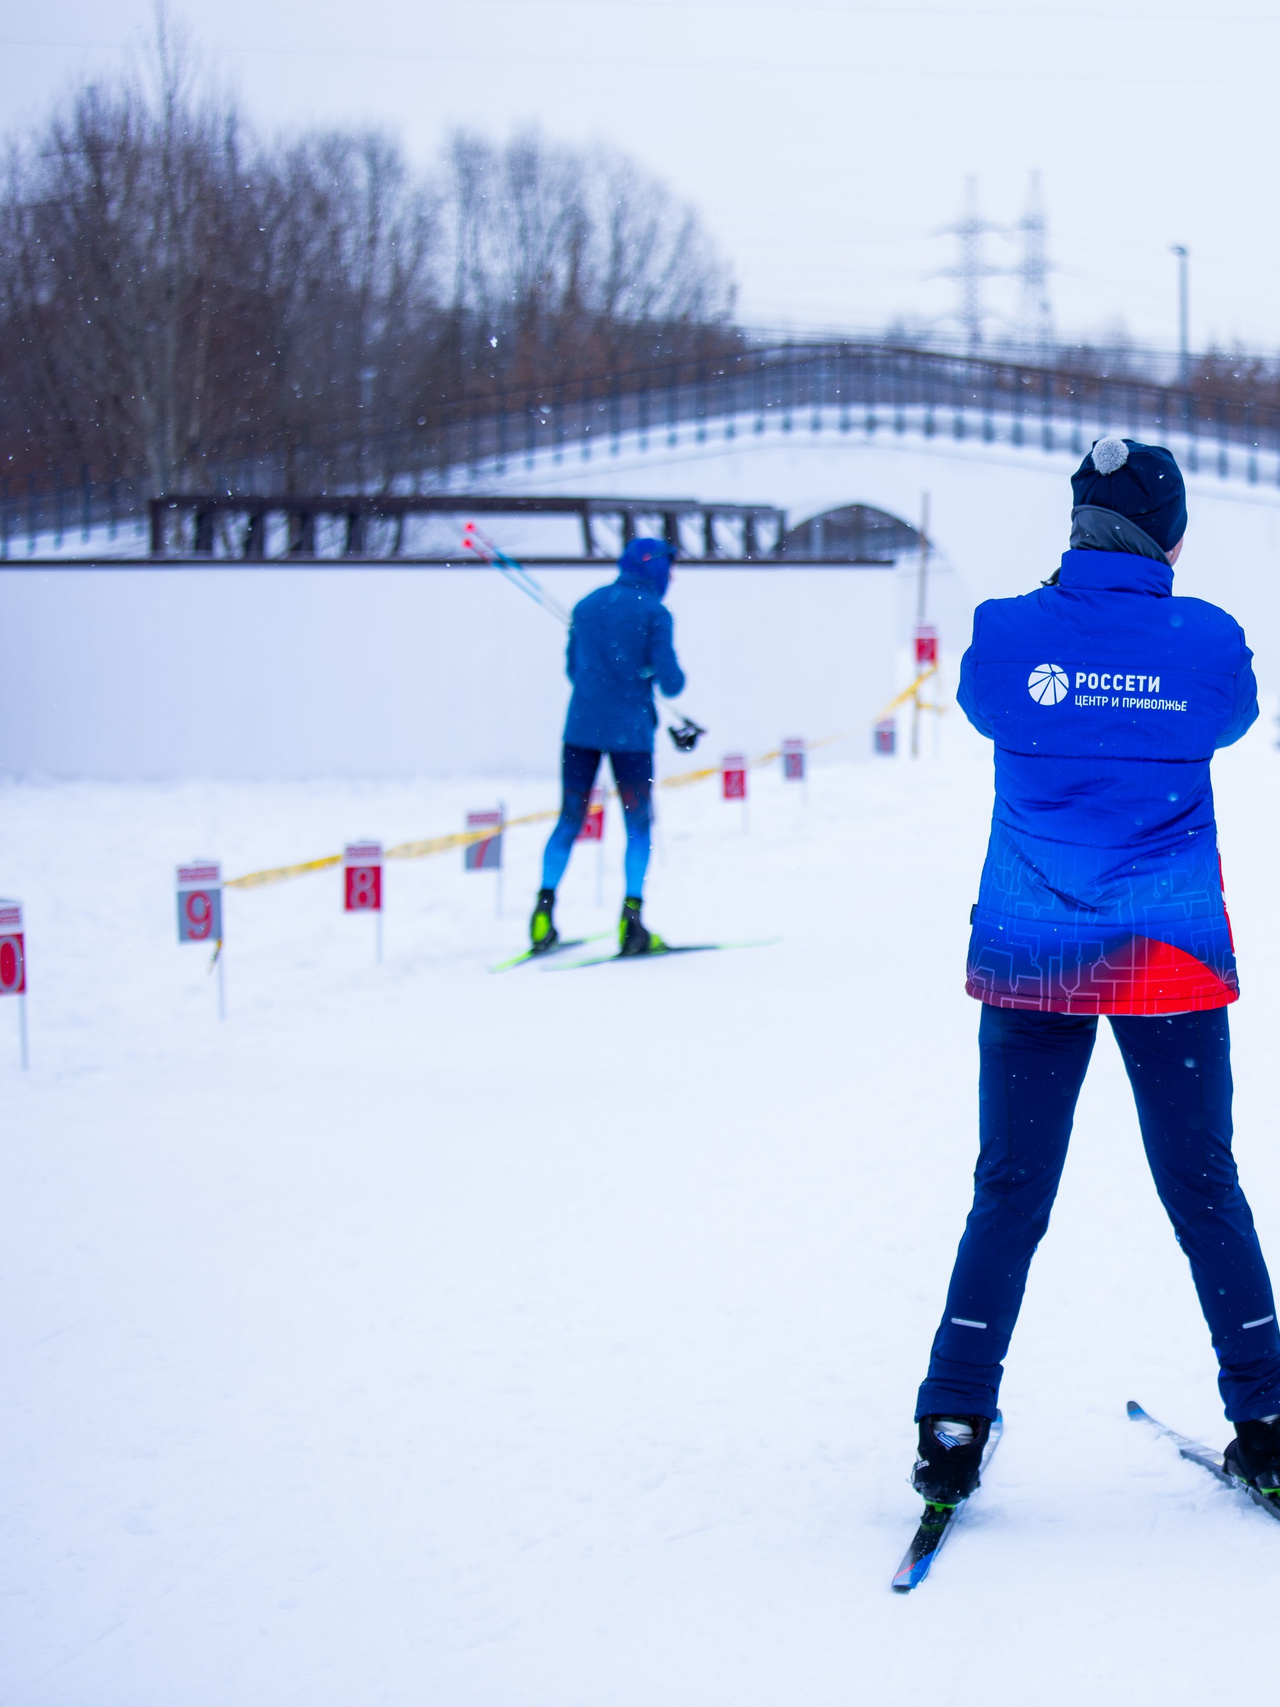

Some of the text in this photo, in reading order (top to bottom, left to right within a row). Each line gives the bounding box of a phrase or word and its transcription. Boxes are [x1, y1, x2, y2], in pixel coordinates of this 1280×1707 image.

[1075, 672, 1160, 693] РОССЕТИ
[1074, 695, 1188, 711] ЦЕНТР И ПРИВОЛЖЬЕ
[350, 867, 376, 910] 8
[186, 891, 213, 941] 9
